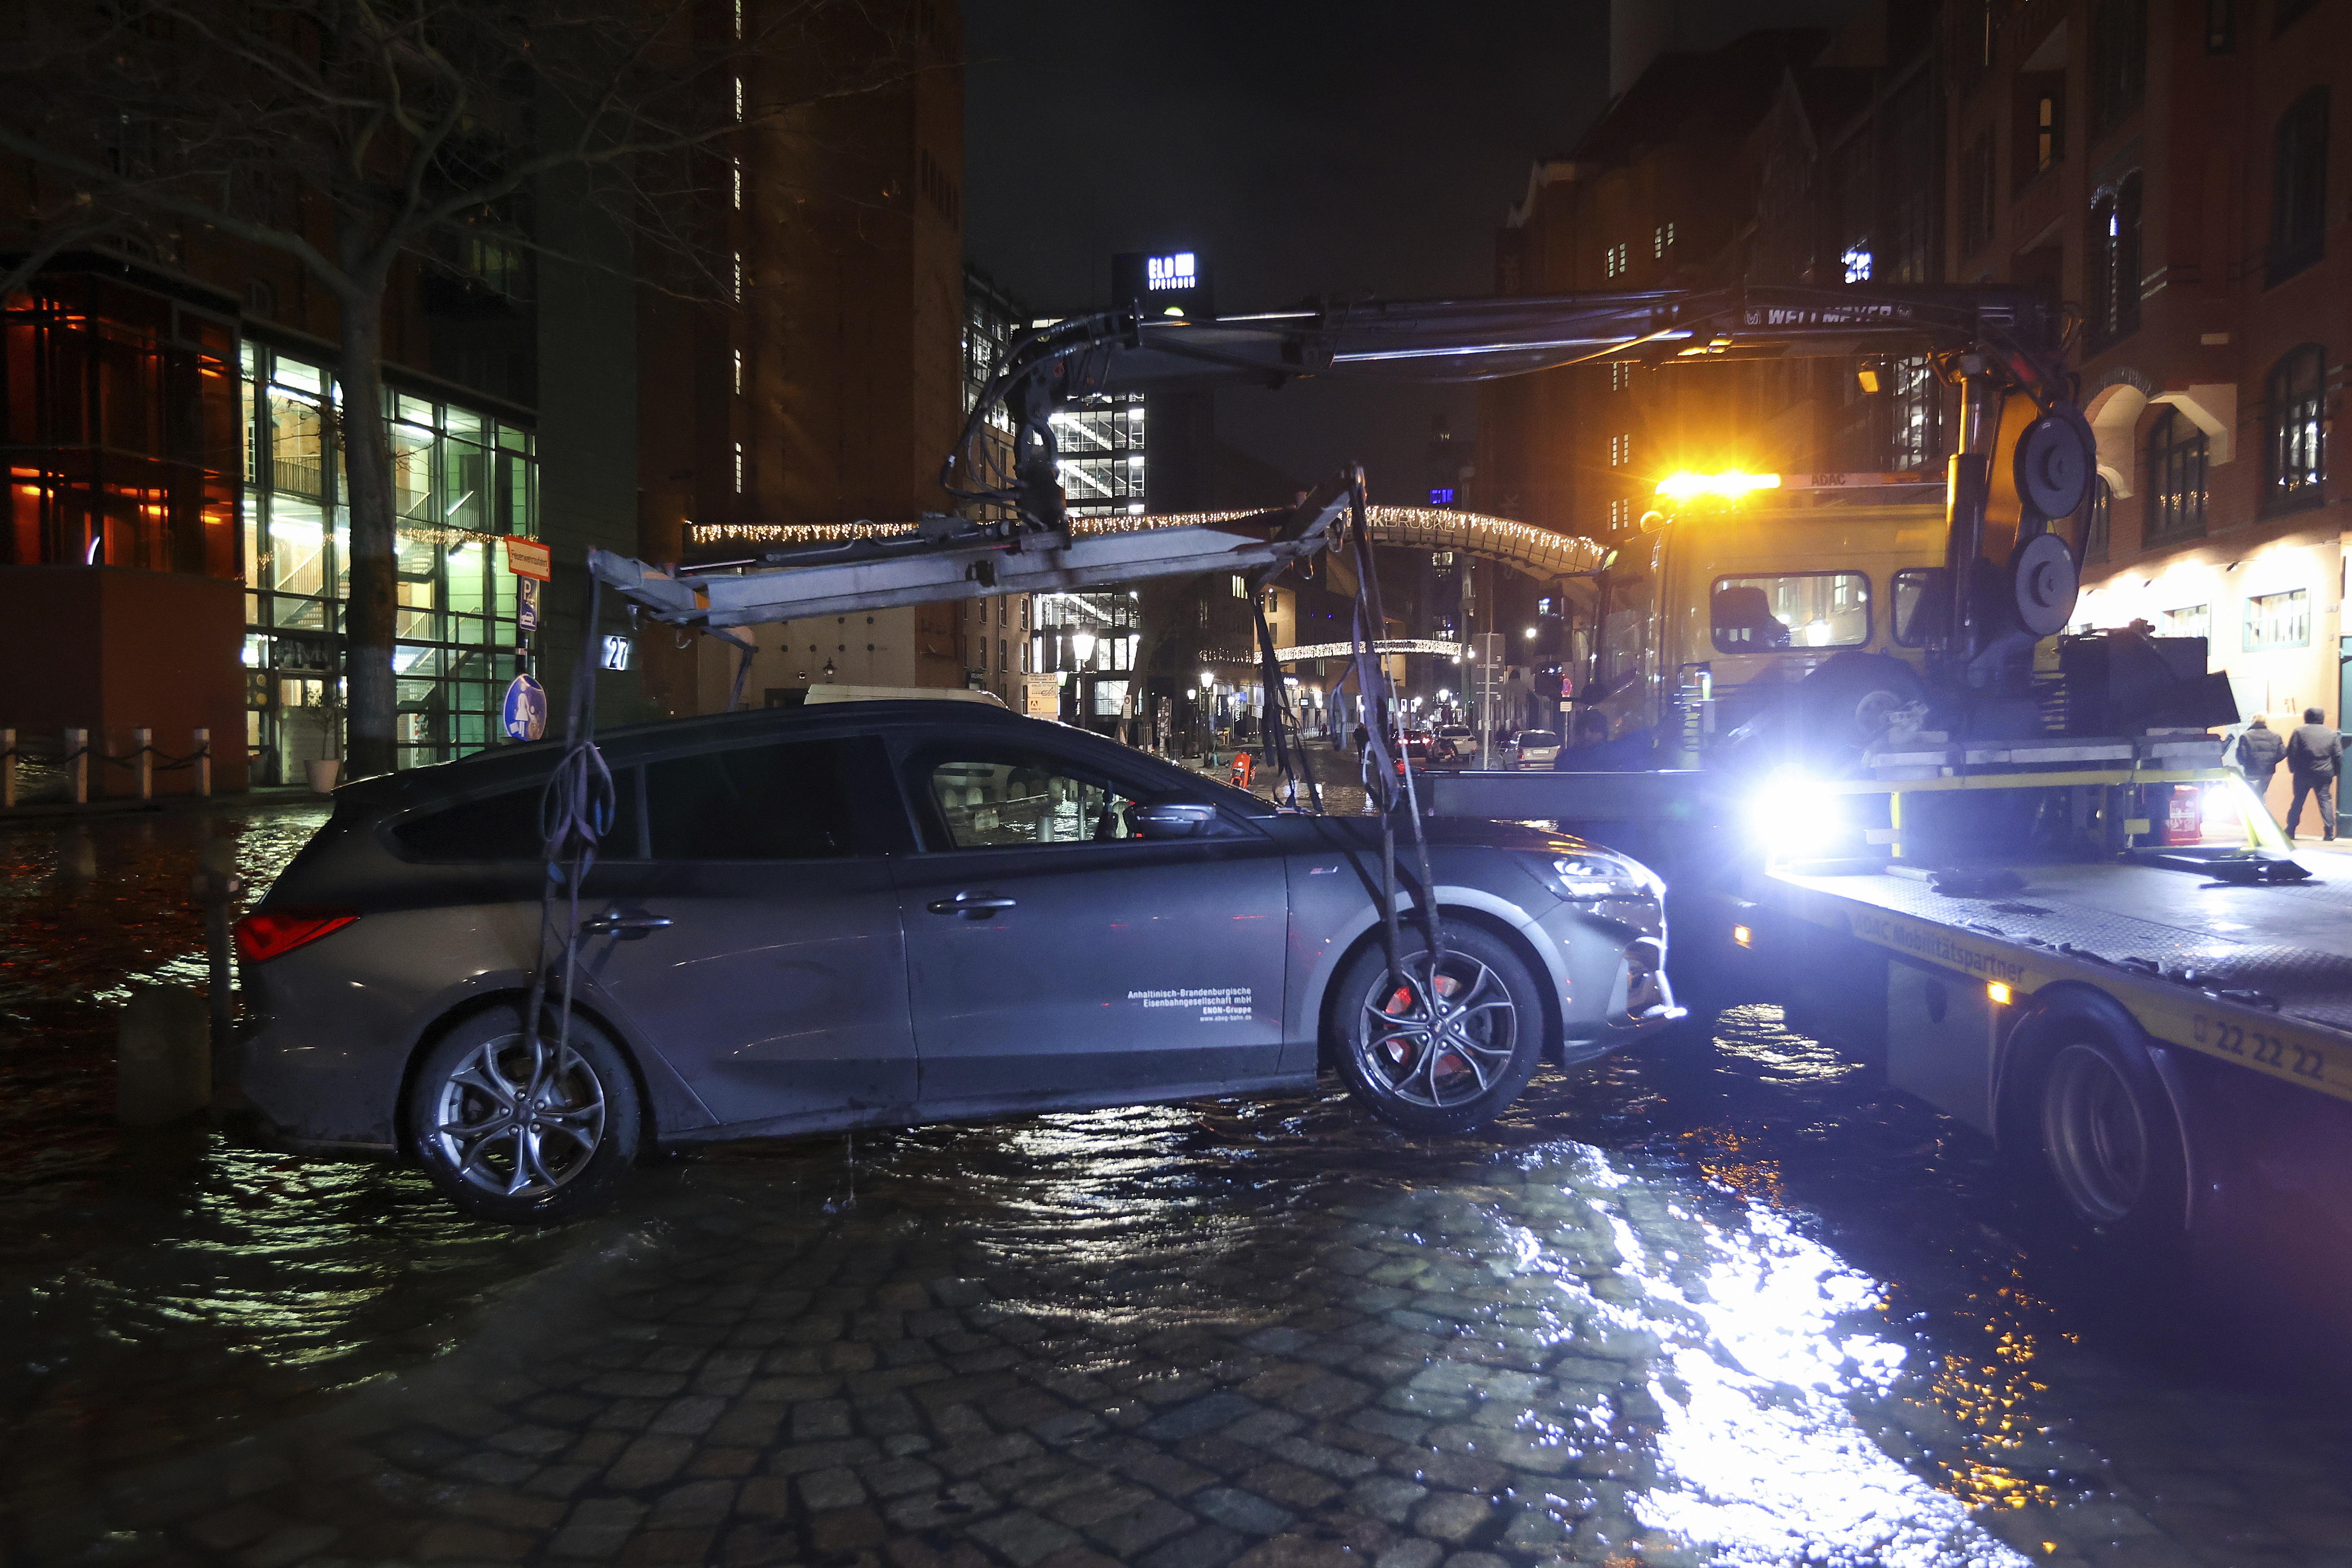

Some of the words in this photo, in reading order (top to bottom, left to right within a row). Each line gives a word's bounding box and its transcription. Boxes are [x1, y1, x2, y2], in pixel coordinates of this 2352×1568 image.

[1812, 475, 1846, 485] ADAC
[609, 637, 628, 668] 27
[1893, 924, 2025, 984] Mobilitätspartner
[1144, 996, 1231, 1008] Eisenbahngesellschaft
[1234, 996, 1252, 1004] mbH
[2217, 1021, 2244, 1055] 22
[2252, 1033, 2283, 1068] 22
[2292, 1043, 2324, 1081] 22
